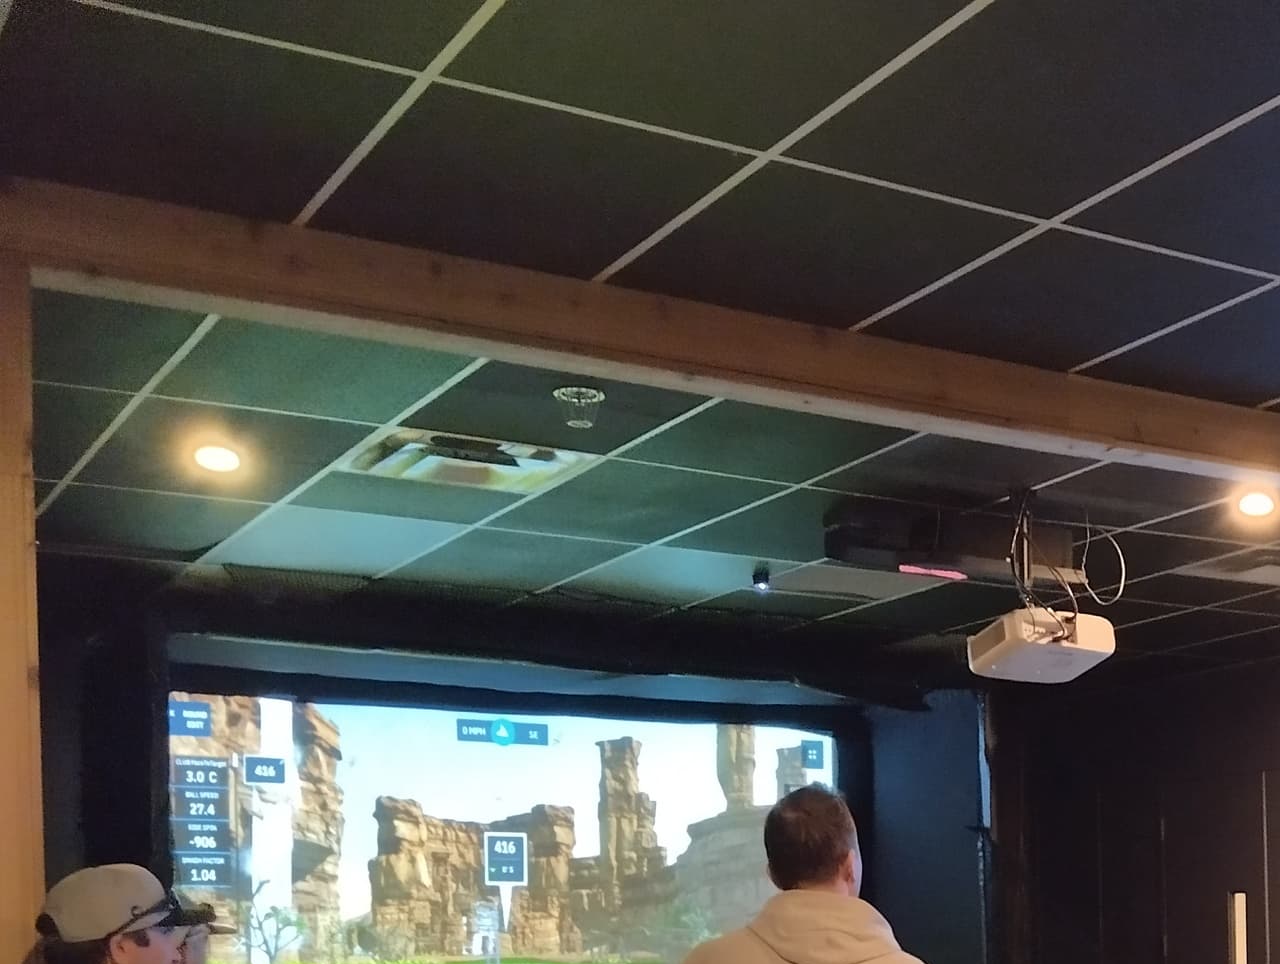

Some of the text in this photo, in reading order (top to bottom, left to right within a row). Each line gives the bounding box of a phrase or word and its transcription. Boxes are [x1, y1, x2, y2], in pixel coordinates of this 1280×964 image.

[186, 770, 218, 783] 3.0 C
[189, 803, 216, 815] 27.4
[494, 840, 516, 854] 416
[190, 869, 217, 882] 1.04
